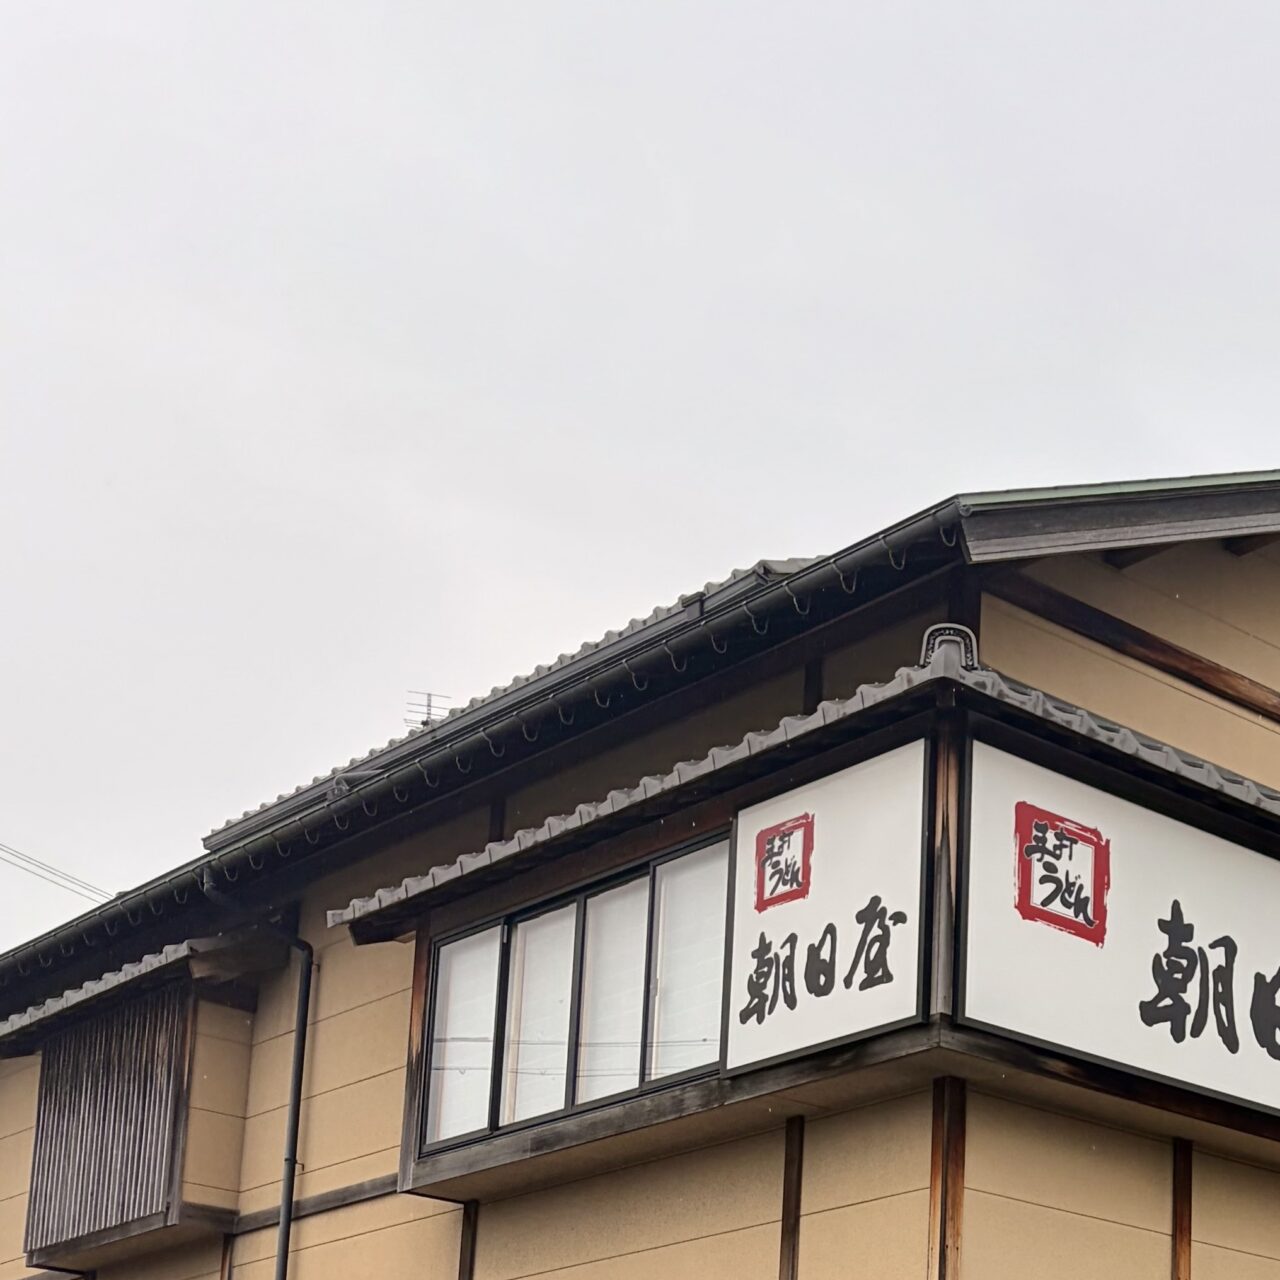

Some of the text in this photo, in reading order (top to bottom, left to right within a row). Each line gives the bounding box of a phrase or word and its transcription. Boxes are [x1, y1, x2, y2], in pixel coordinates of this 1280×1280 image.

[769, 855, 803, 896] うどん
[1038, 861, 1096, 928] うどん
[739, 896, 907, 1025] 朝日屋
